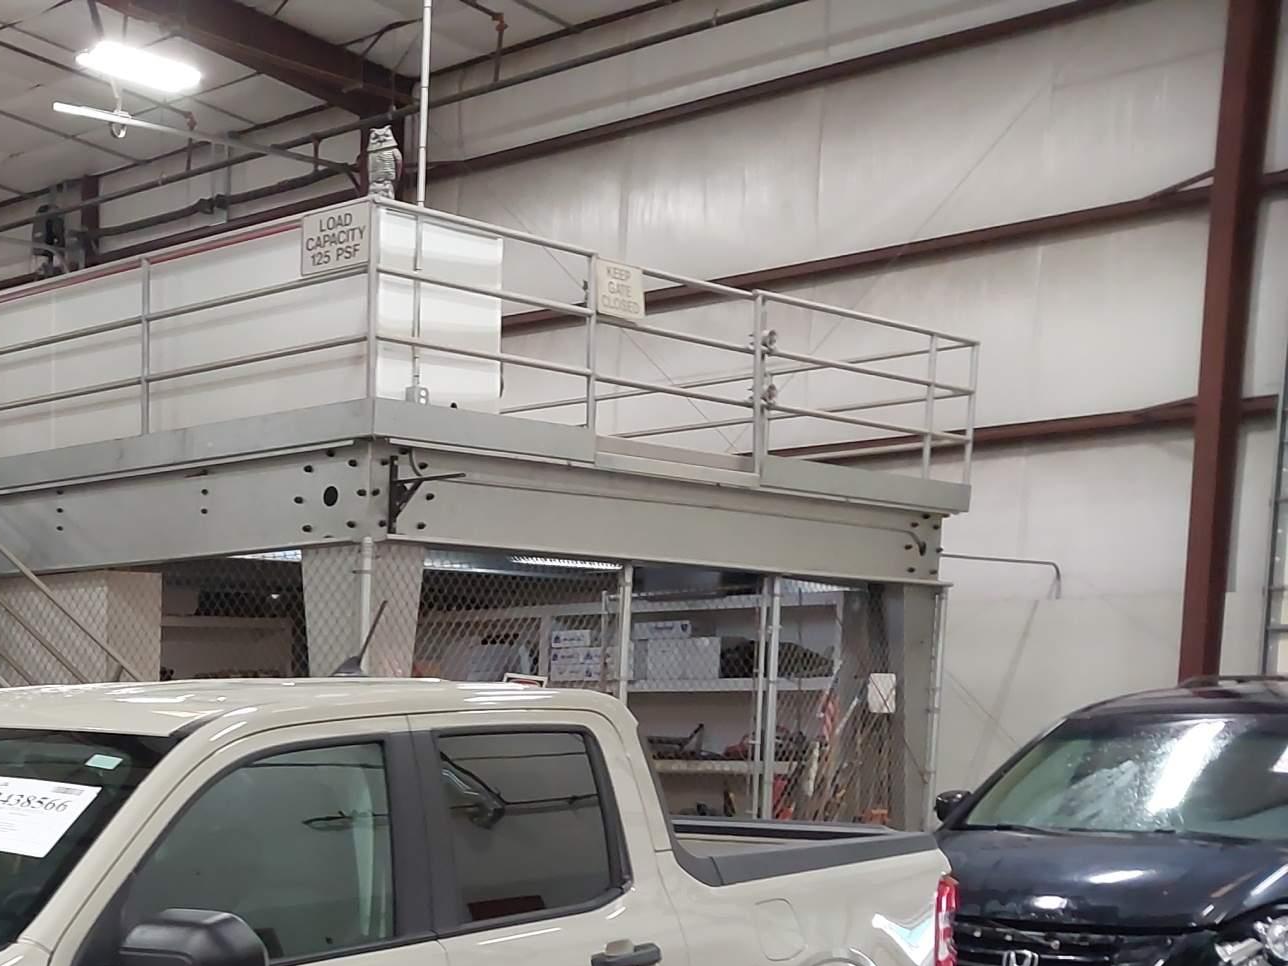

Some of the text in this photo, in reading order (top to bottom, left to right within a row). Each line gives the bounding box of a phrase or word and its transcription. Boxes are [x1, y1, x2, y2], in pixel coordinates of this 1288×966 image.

[319, 212, 353, 233] LOAD
[305, 225, 367, 252] CAPACITY
[310, 243, 361, 267] 125 PSF
[606, 265, 633, 281] KEEP
[607, 280, 633, 298] GATE
[600, 294, 642, 315] CLOSED
